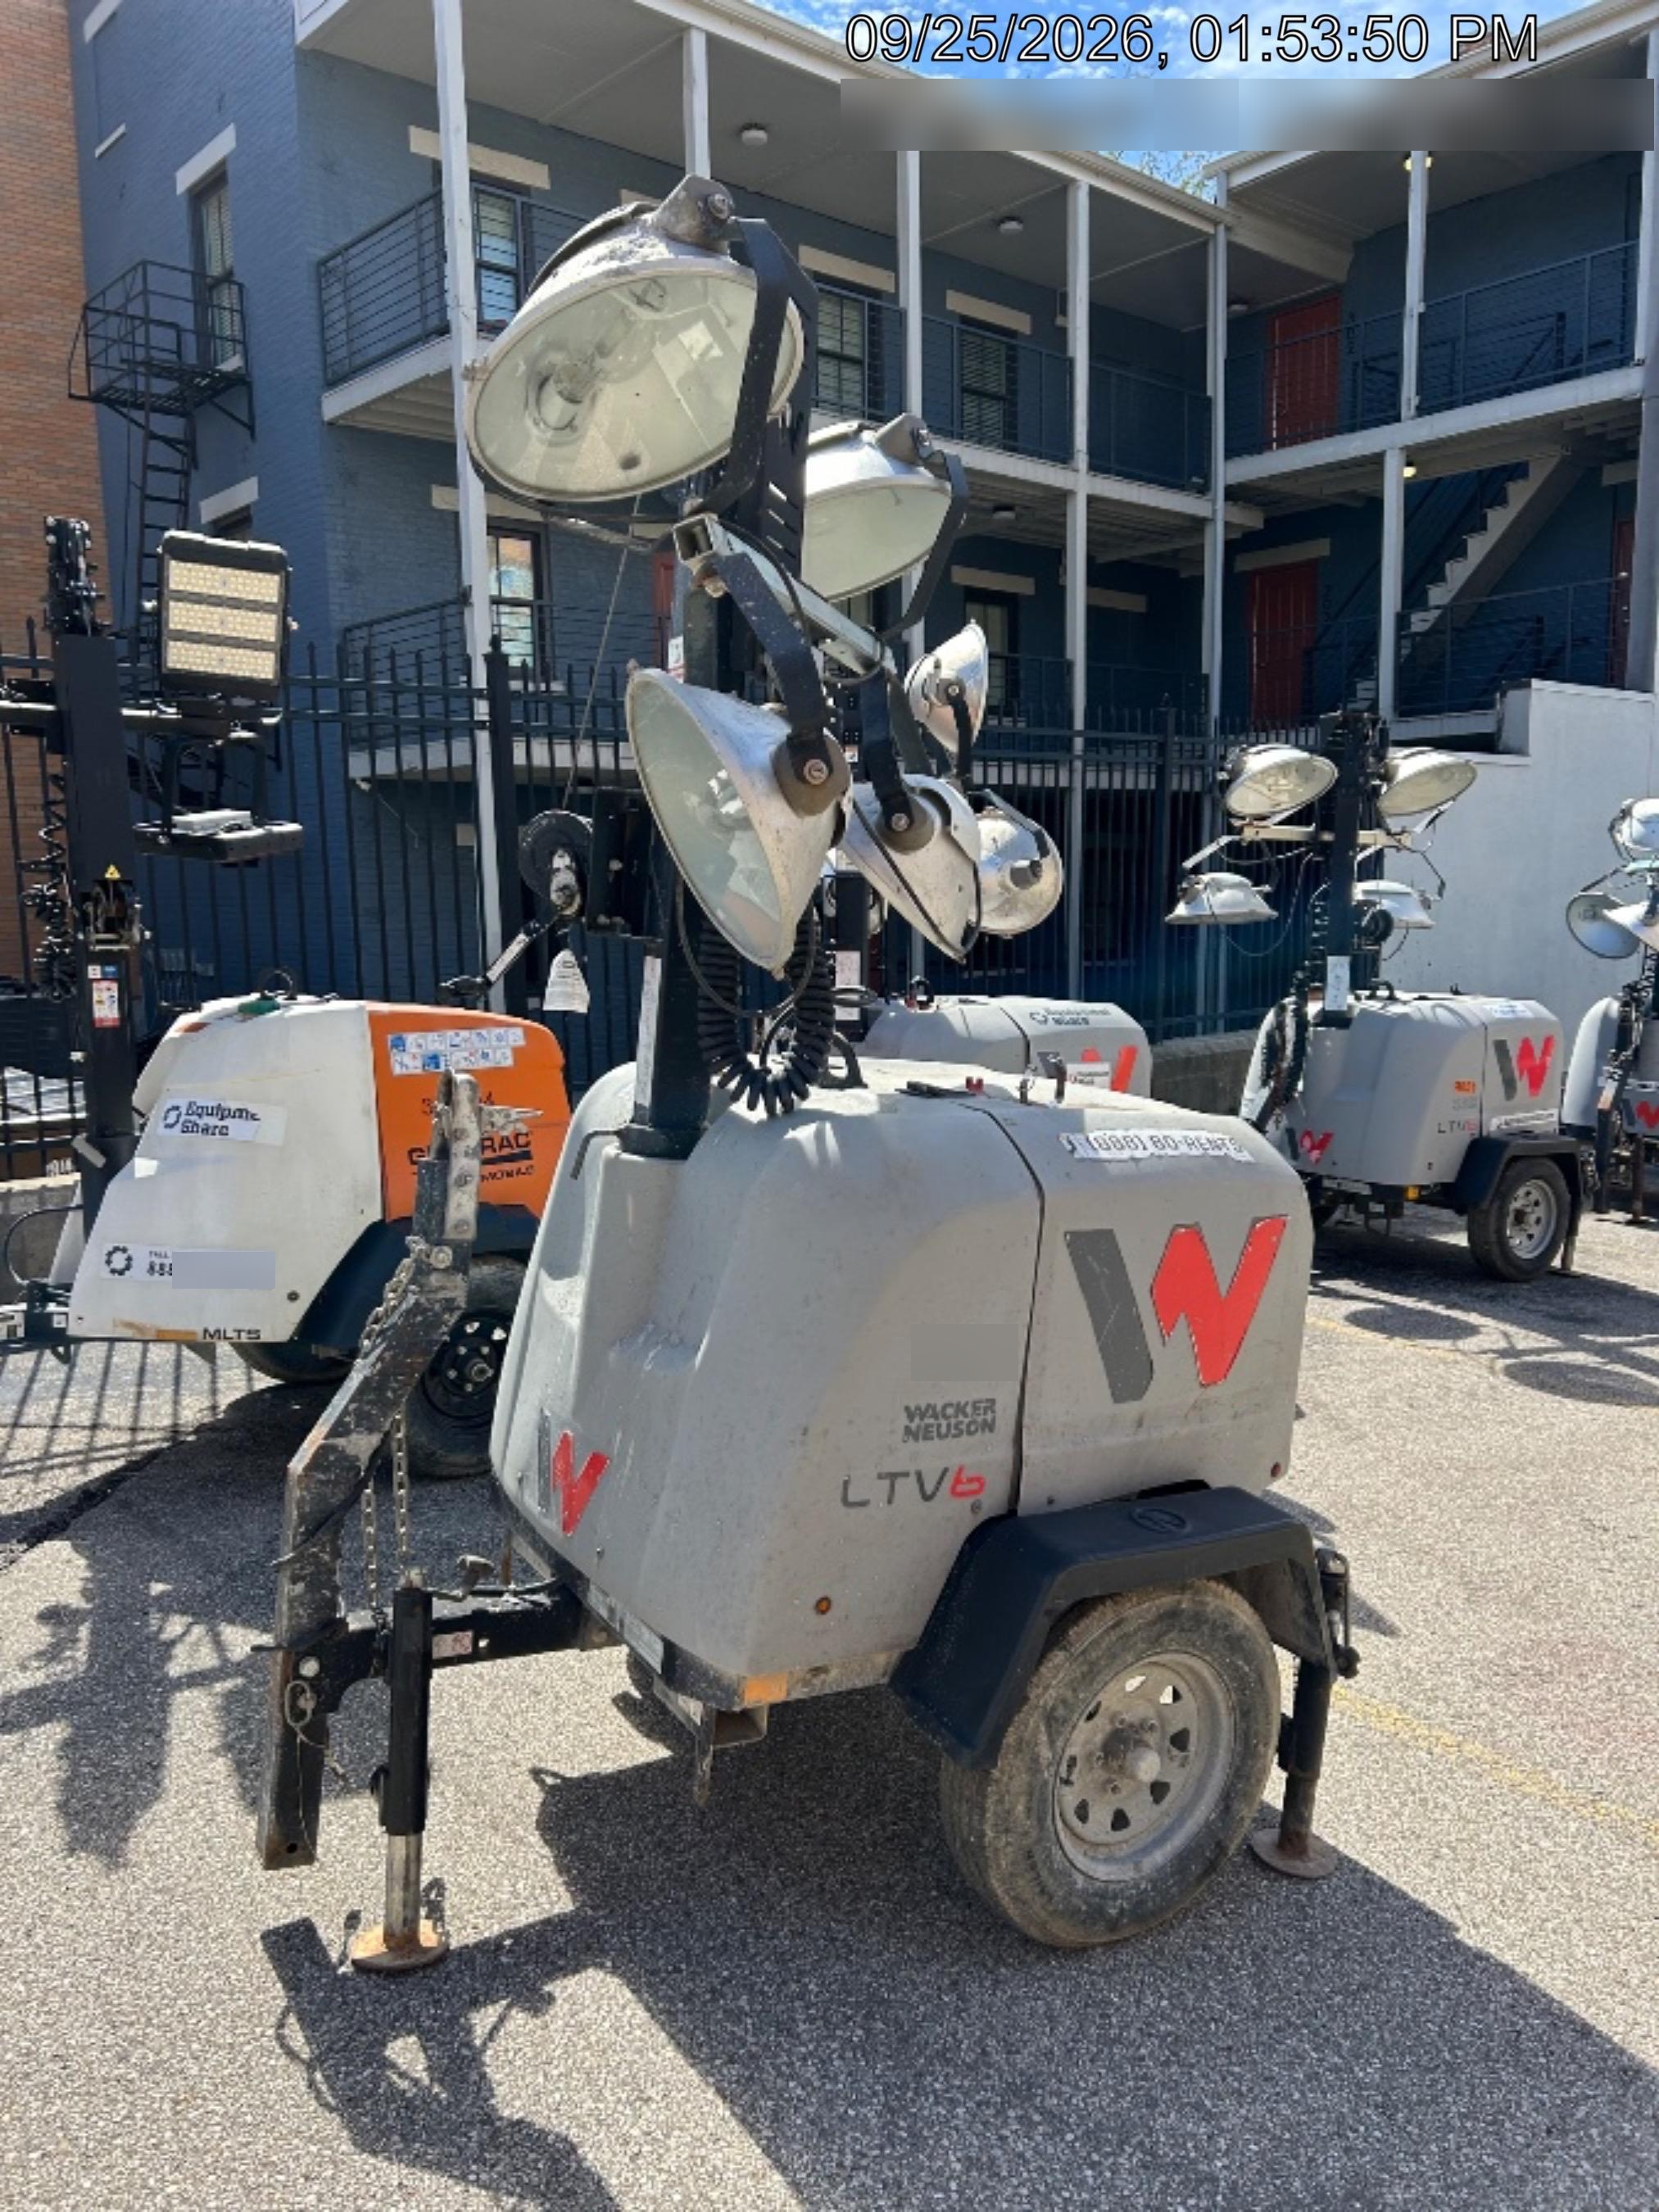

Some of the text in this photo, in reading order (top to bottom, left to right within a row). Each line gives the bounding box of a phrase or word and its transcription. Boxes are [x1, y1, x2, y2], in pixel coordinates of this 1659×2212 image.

[904, 1398, 996, 1423] WACKER
[902, 1416, 996, 1443] NEUSON
[841, 1464, 986, 1507] LTV6
